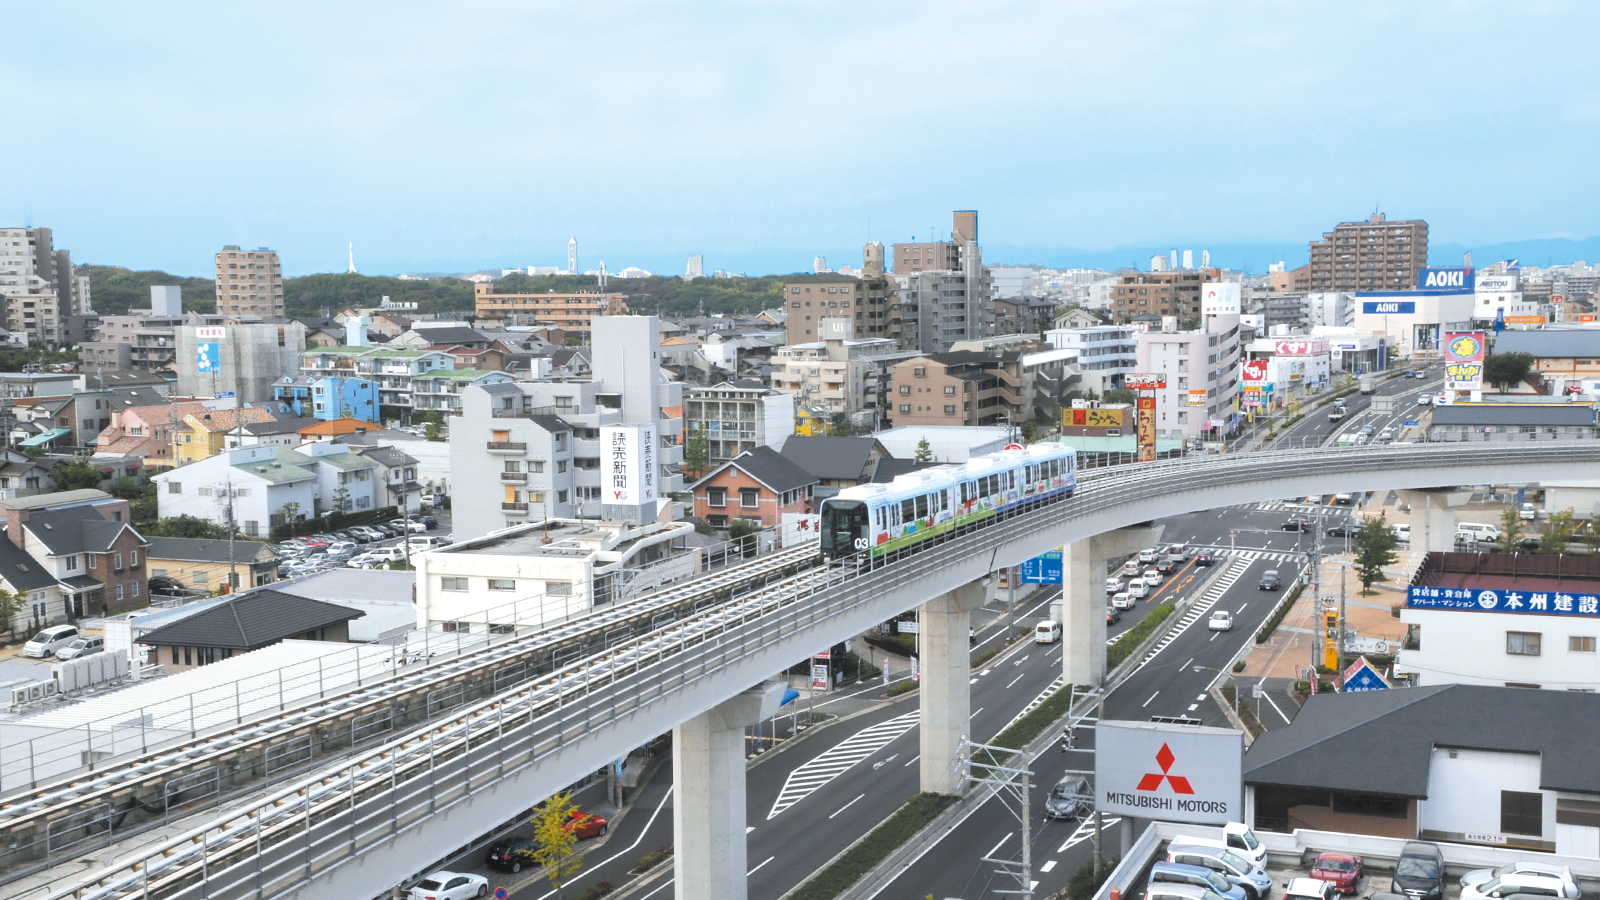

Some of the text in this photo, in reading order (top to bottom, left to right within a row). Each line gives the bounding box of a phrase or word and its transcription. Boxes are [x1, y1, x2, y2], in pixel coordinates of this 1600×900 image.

[1425, 271, 1464, 287] AOKI
[1376, 302, 1399, 312] AOKI
[1276, 341, 1313, 354] くすり
[1243, 360, 1266, 380] くすり
[612, 431, 627, 488] 読売新聞
[854, 538, 869, 549] 03
[1504, 591, 1599, 614] 本州建設
[1106, 791, 1227, 814] MITSUBISHI MOTORS
